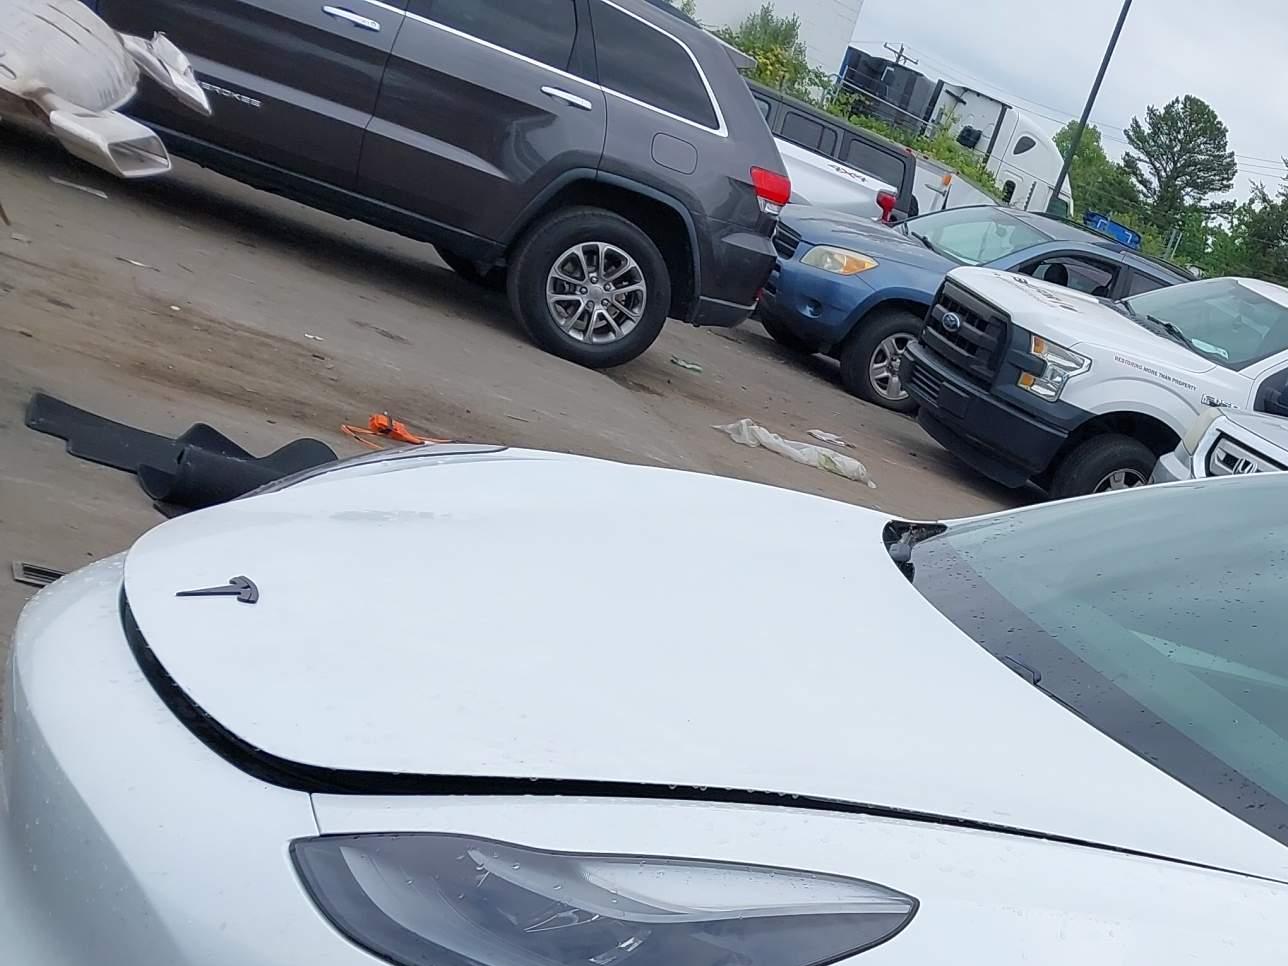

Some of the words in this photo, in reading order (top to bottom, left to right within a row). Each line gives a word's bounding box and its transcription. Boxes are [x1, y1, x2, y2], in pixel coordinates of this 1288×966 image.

[1143, 366, 1158, 377] MORE
[1159, 372, 1171, 381] THAN
[1172, 377, 1197, 391] PROPERTY
